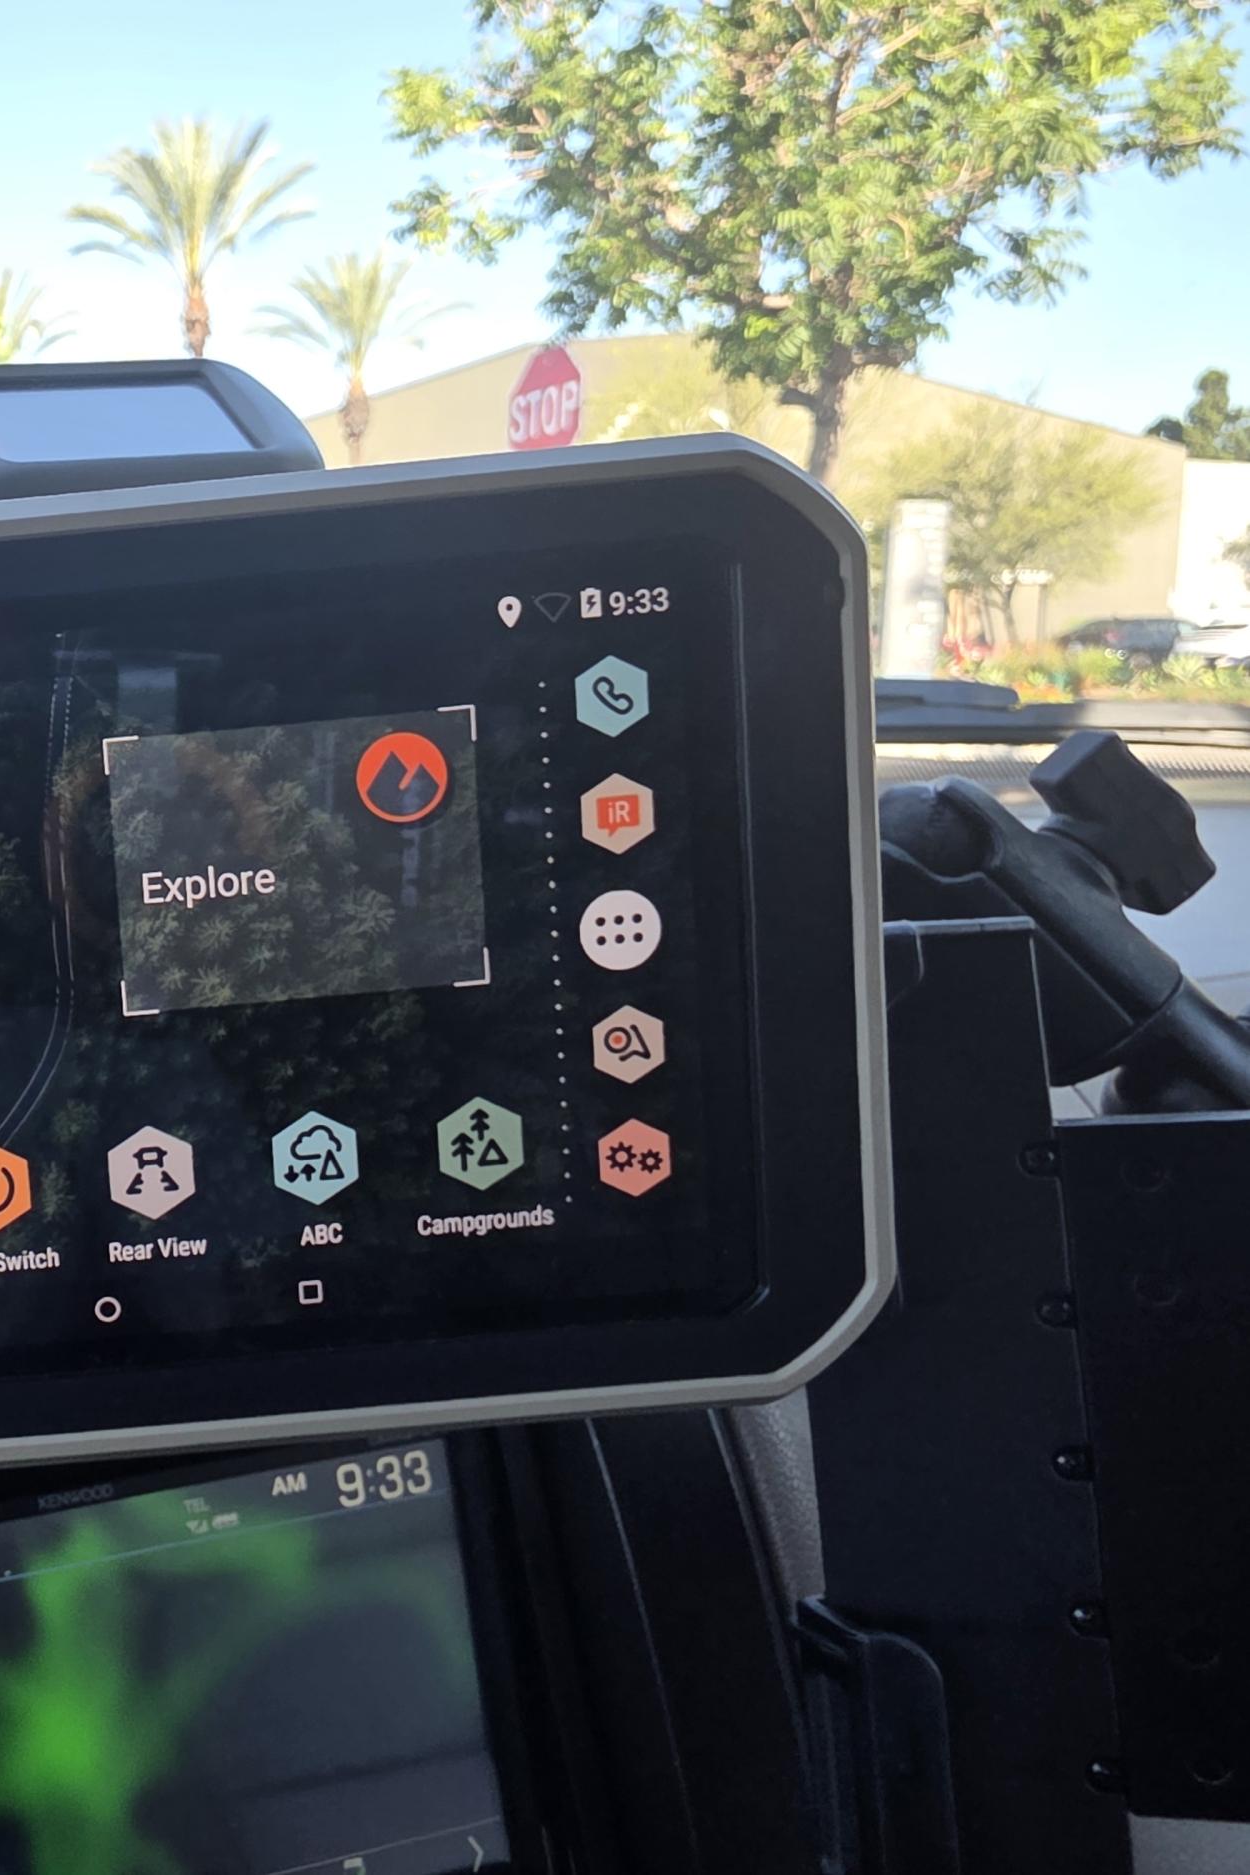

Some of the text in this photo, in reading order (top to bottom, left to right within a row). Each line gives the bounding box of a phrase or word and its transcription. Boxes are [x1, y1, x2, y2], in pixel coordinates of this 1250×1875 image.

[509, 379, 579, 444] STOP
[608, 586, 670, 616] 9:33
[141, 865, 277, 909] Explore
[299, 1222, 344, 1247] ABC
[416, 1203, 556, 1238] Campgrounds
[107, 1235, 208, 1264] Rear View
[270, 1448, 434, 1510] AM 9:33
